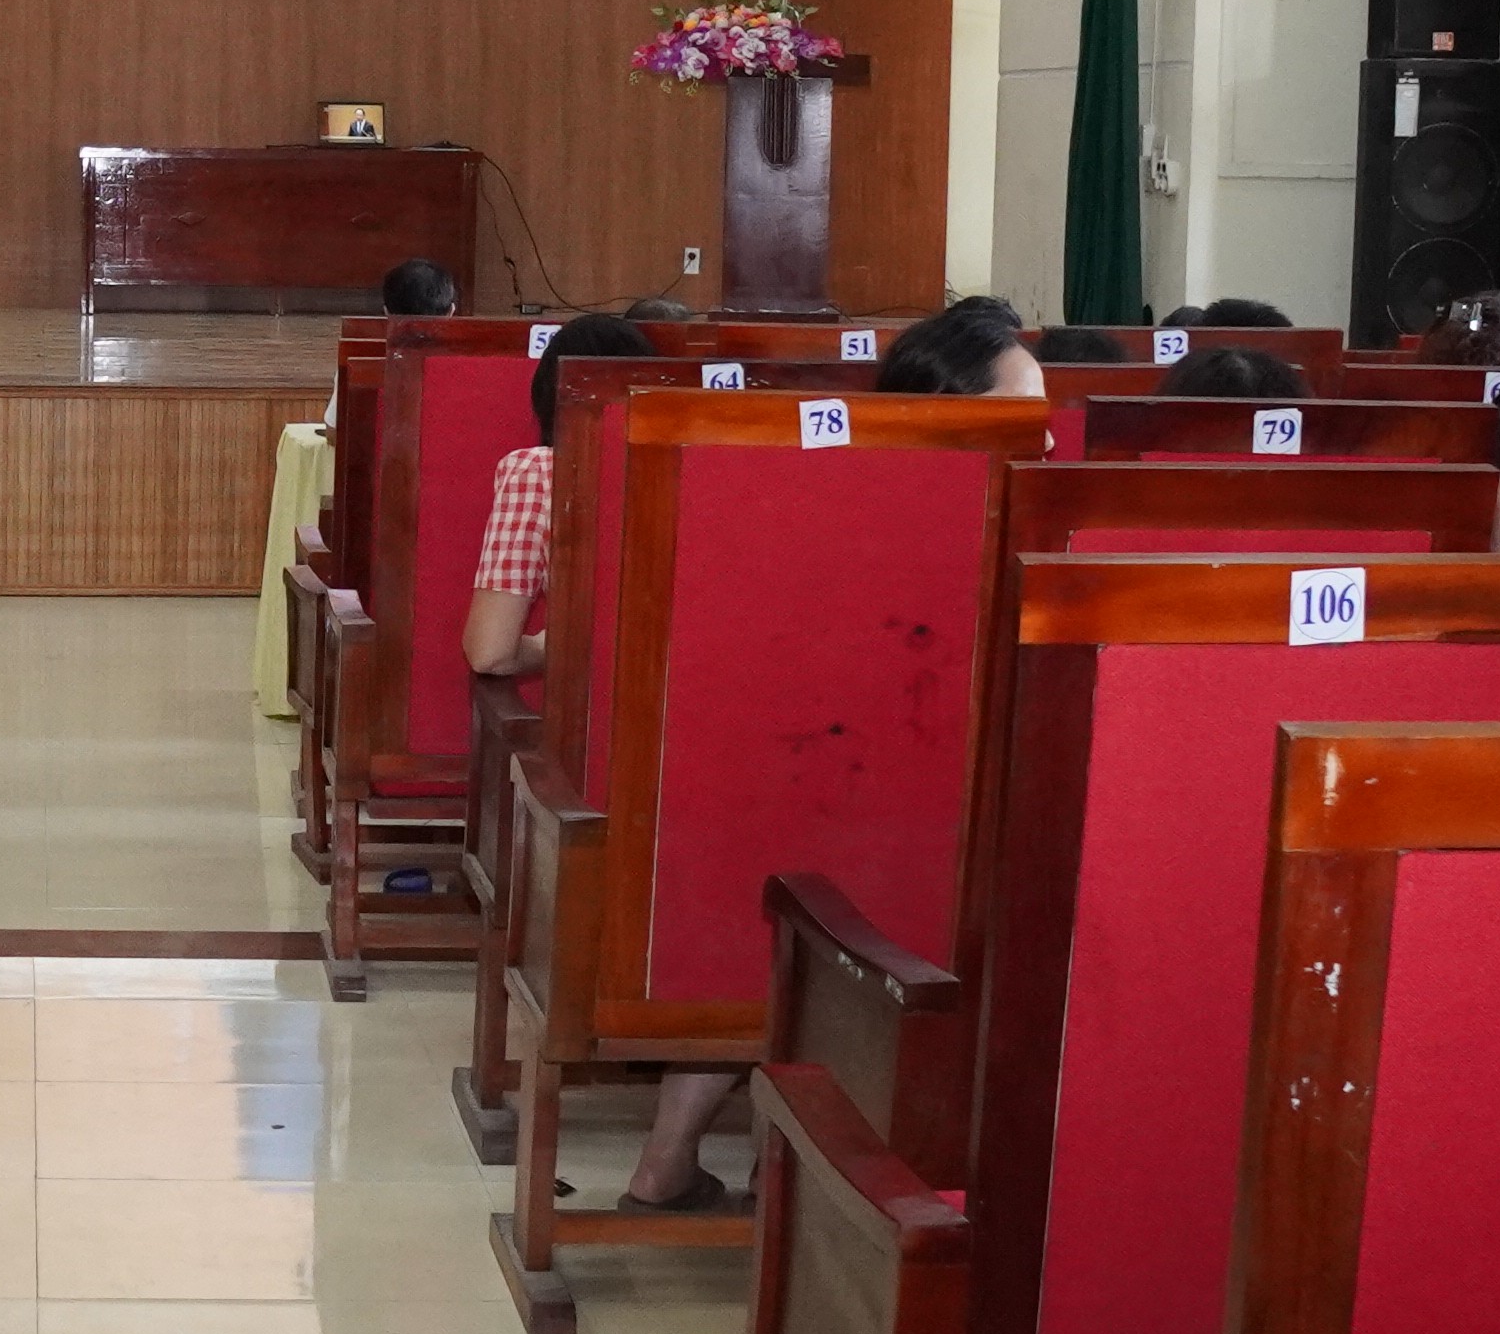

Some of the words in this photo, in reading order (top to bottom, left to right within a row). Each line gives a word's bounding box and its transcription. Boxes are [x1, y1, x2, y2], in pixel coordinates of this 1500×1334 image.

[846, 337, 869, 355] 51
[1160, 336, 1184, 355] 52
[709, 371, 740, 390] 64
[808, 408, 844, 436] 78
[1262, 418, 1296, 445] 79
[1302, 582, 1355, 625] 106
